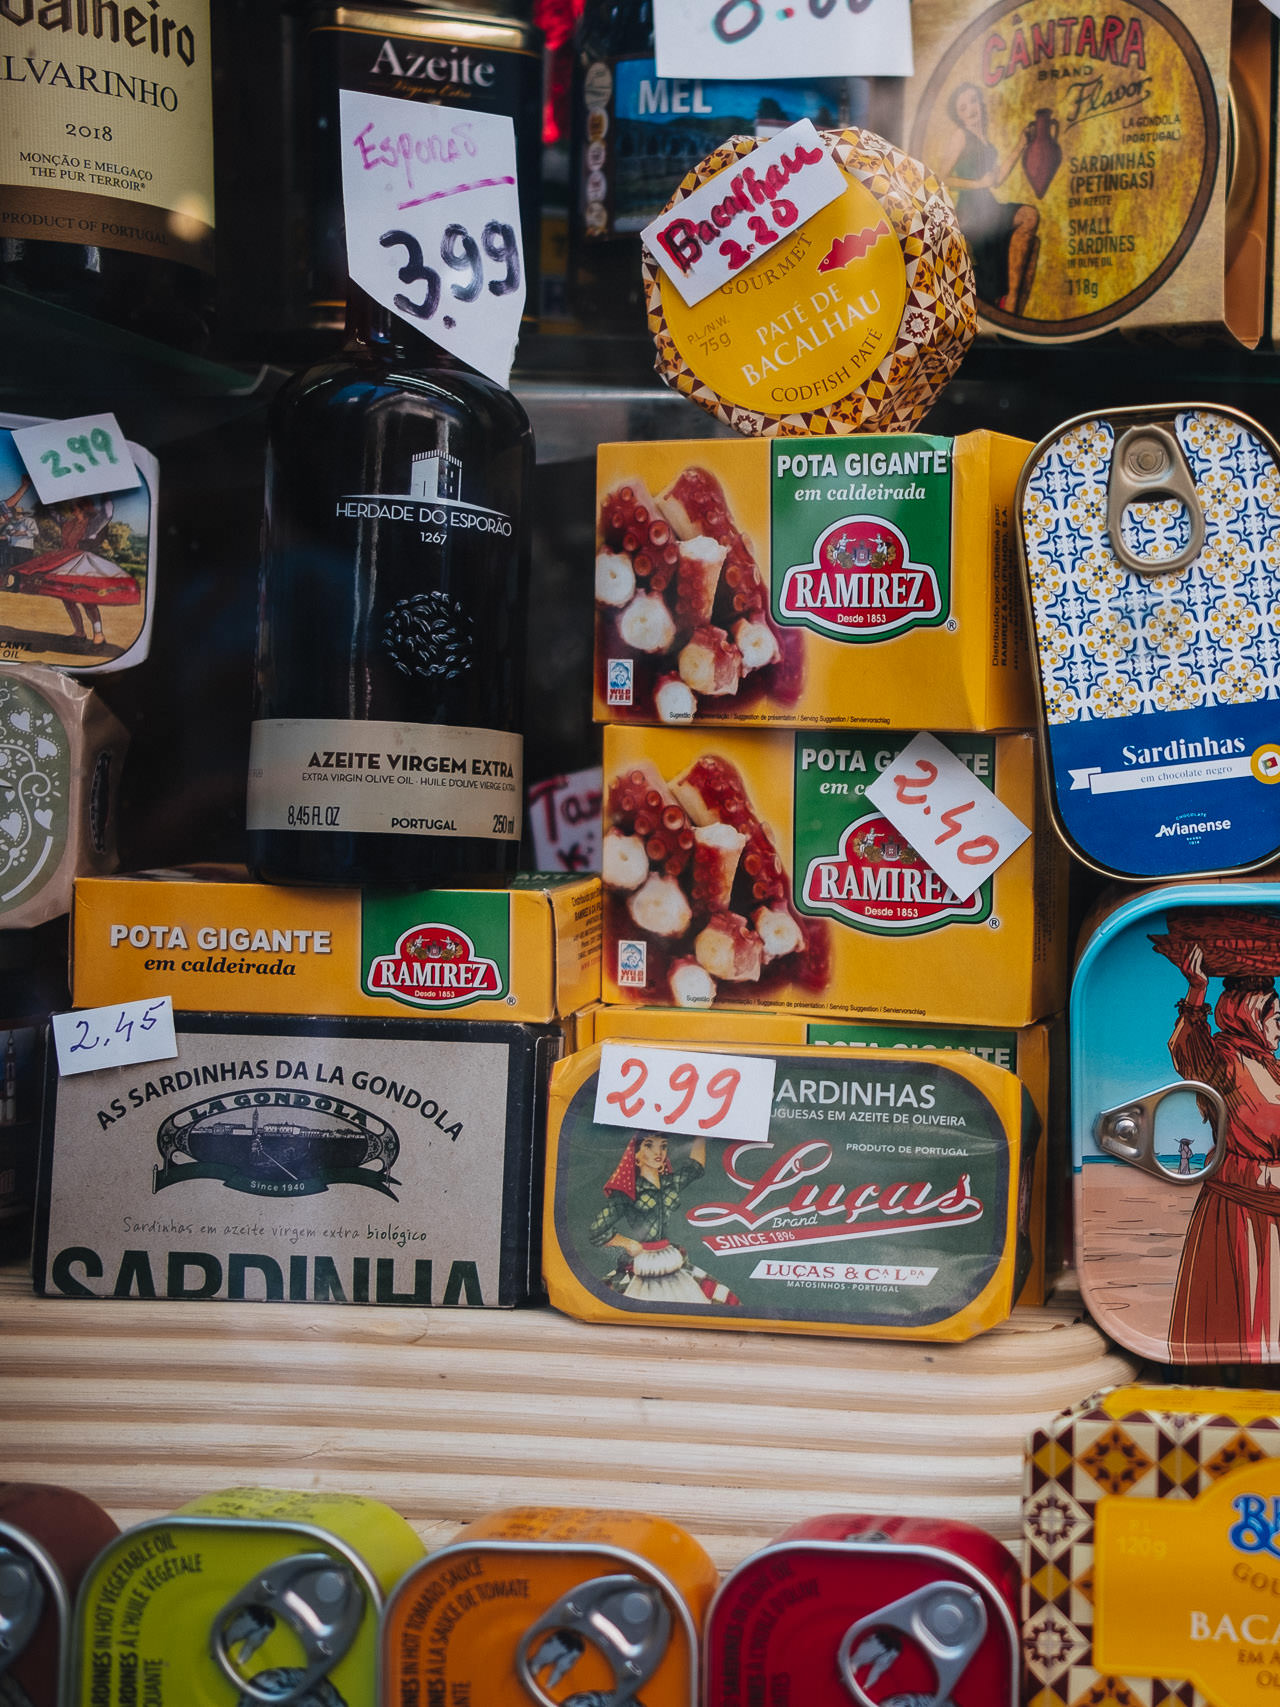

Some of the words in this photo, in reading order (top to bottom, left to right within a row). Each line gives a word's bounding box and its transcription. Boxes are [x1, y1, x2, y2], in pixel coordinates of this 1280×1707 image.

[369, 38, 495, 87] Azeite
[982, 14, 1146, 87] CÂNTARA
[0, 55, 178, 112] LVARINHO
[1037, 66, 1093, 81] BRAND
[638, 80, 713, 116] MEL
[1066, 76, 1152, 122] Flavor
[65, 123, 113, 142] 2018
[19, 151, 80, 168] MONÇÃO
[94, 161, 153, 182] MELGAÇO
[30, 166, 56, 178] THE
[60, 170, 85, 182] PUR
[1070, 151, 1156, 174] SARDINHAS
[1070, 172, 1155, 194] (PETINGAS)
[2, 211, 75, 229] PRODUCT
[78, 220, 97, 231] OF
[101, 223, 169, 245] PORTUGAL
[1068, 218, 1113, 236] SMALL
[1068, 236, 1135, 256] SARDINES
[379, 221, 522, 329] 3.99
[720, 232, 814, 296] GOURMET
[1068, 278, 1098, 297] 118g
[757, 302, 808, 346] PATÉ
[810, 283, 843, 314] DE
[700, 332, 731, 357] 75g
[741, 289, 881, 386] BACALHAU
[771, 367, 851, 402] CODFISH
[851, 328, 883, 369] PATÉ
[40, 428, 119, 478] 2.99
[777, 454, 834, 478] POTA
[844, 450, 948, 477] GIGANTE
[794, 488, 826, 501] em
[827, 482, 926, 501] caldeirada
[336, 503, 414, 522] HERDADE
[419, 508, 447, 524] DO
[450, 512, 512, 536] ESPORÃO
[420, 531, 447, 545] 1267
[795, 572, 925, 609] RAMIREZ
[837, 612, 864, 624] Desde
[866, 613, 887, 624] 1853
[802, 749, 866, 772] POTA
[1122, 737, 1245, 766] Sardinhas
[308, 752, 381, 770] AZEITE
[387, 754, 467, 774] VIRGEM
[472, 760, 514, 778] EXTRA
[1158, 769, 1202, 781] chocolate
[1205, 766, 1232, 777] negro
[302, 773, 328, 782] EXTRA
[330, 773, 363, 783] VIRGIN
[365, 774, 395, 784] OLIVE
[397, 775, 414, 785] OIL
[420, 776, 447, 787] HUILE
[820, 782, 848, 795] em
[288, 805, 310, 826] 8,45
[325, 806, 340, 826] OZ
[391, 817, 457, 831] PORTUGAL
[492, 814, 507, 833] 250
[894, 759, 1000, 865] 2.40
[1155, 819, 1231, 837] Avianense
[865, 907, 893, 917] Desde
[897, 907, 918, 917] 1853
[110, 925, 187, 948] POTA
[199, 927, 331, 954] GIGANTE
[145, 958, 176, 972] em
[181, 956, 296, 976] caldeirada
[380, 961, 488, 989] RAMIREZ
[69, 1001, 166, 1053] 2.45
[96, 1098, 126, 1131] AS
[129, 1059, 268, 1108] SARDINHAS
[275, 1060, 307, 1080] DA
[316, 1063, 345, 1085] LA
[351, 1070, 464, 1142] GONDOLA
[607, 1058, 742, 1130] 2.99
[771, 1079, 936, 1109] ARDINHAS
[234, 1092, 368, 1127] GONDOLA
[827, 1110, 846, 1121] EM
[849, 1111, 890, 1123] AZEITE
[892, 1113, 909, 1124] DE
[912, 1115, 966, 1127] OLIVEIRA
[846, 1143, 895, 1153] PRODUTO
[915, 1146, 969, 1157] PORTUGAL
[250, 1180, 279, 1191] Since
[282, 1182, 305, 1191] 1940
[123, 1216, 192, 1234] Sardinhas
[200, 1226, 217, 1235] em
[223, 1223, 265, 1236] azeite
[272, 1224, 316, 1243] virgem
[322, 1227, 360, 1239] extra
[366, 1225, 427, 1247] biológico
[772, 1214, 818, 1228] Brand
[716, 1233, 768, 1250] SINCE
[769, 1231, 795, 1243] 1896
[52, 1246, 485, 1305] SARDINHA
[766, 1264, 835, 1278] LUÇAS
[845, 1267, 858, 1279] &
[787, 1281, 845, 1290] MATOSINHOS
[852, 1284, 899, 1293] PORTUGAL
[153, 1531, 177, 1552] OIL
[101, 1541, 157, 1604] VEGETABLE
[95, 1603, 115, 1632] HOT
[1238, 1648, 1265, 1666] EM
